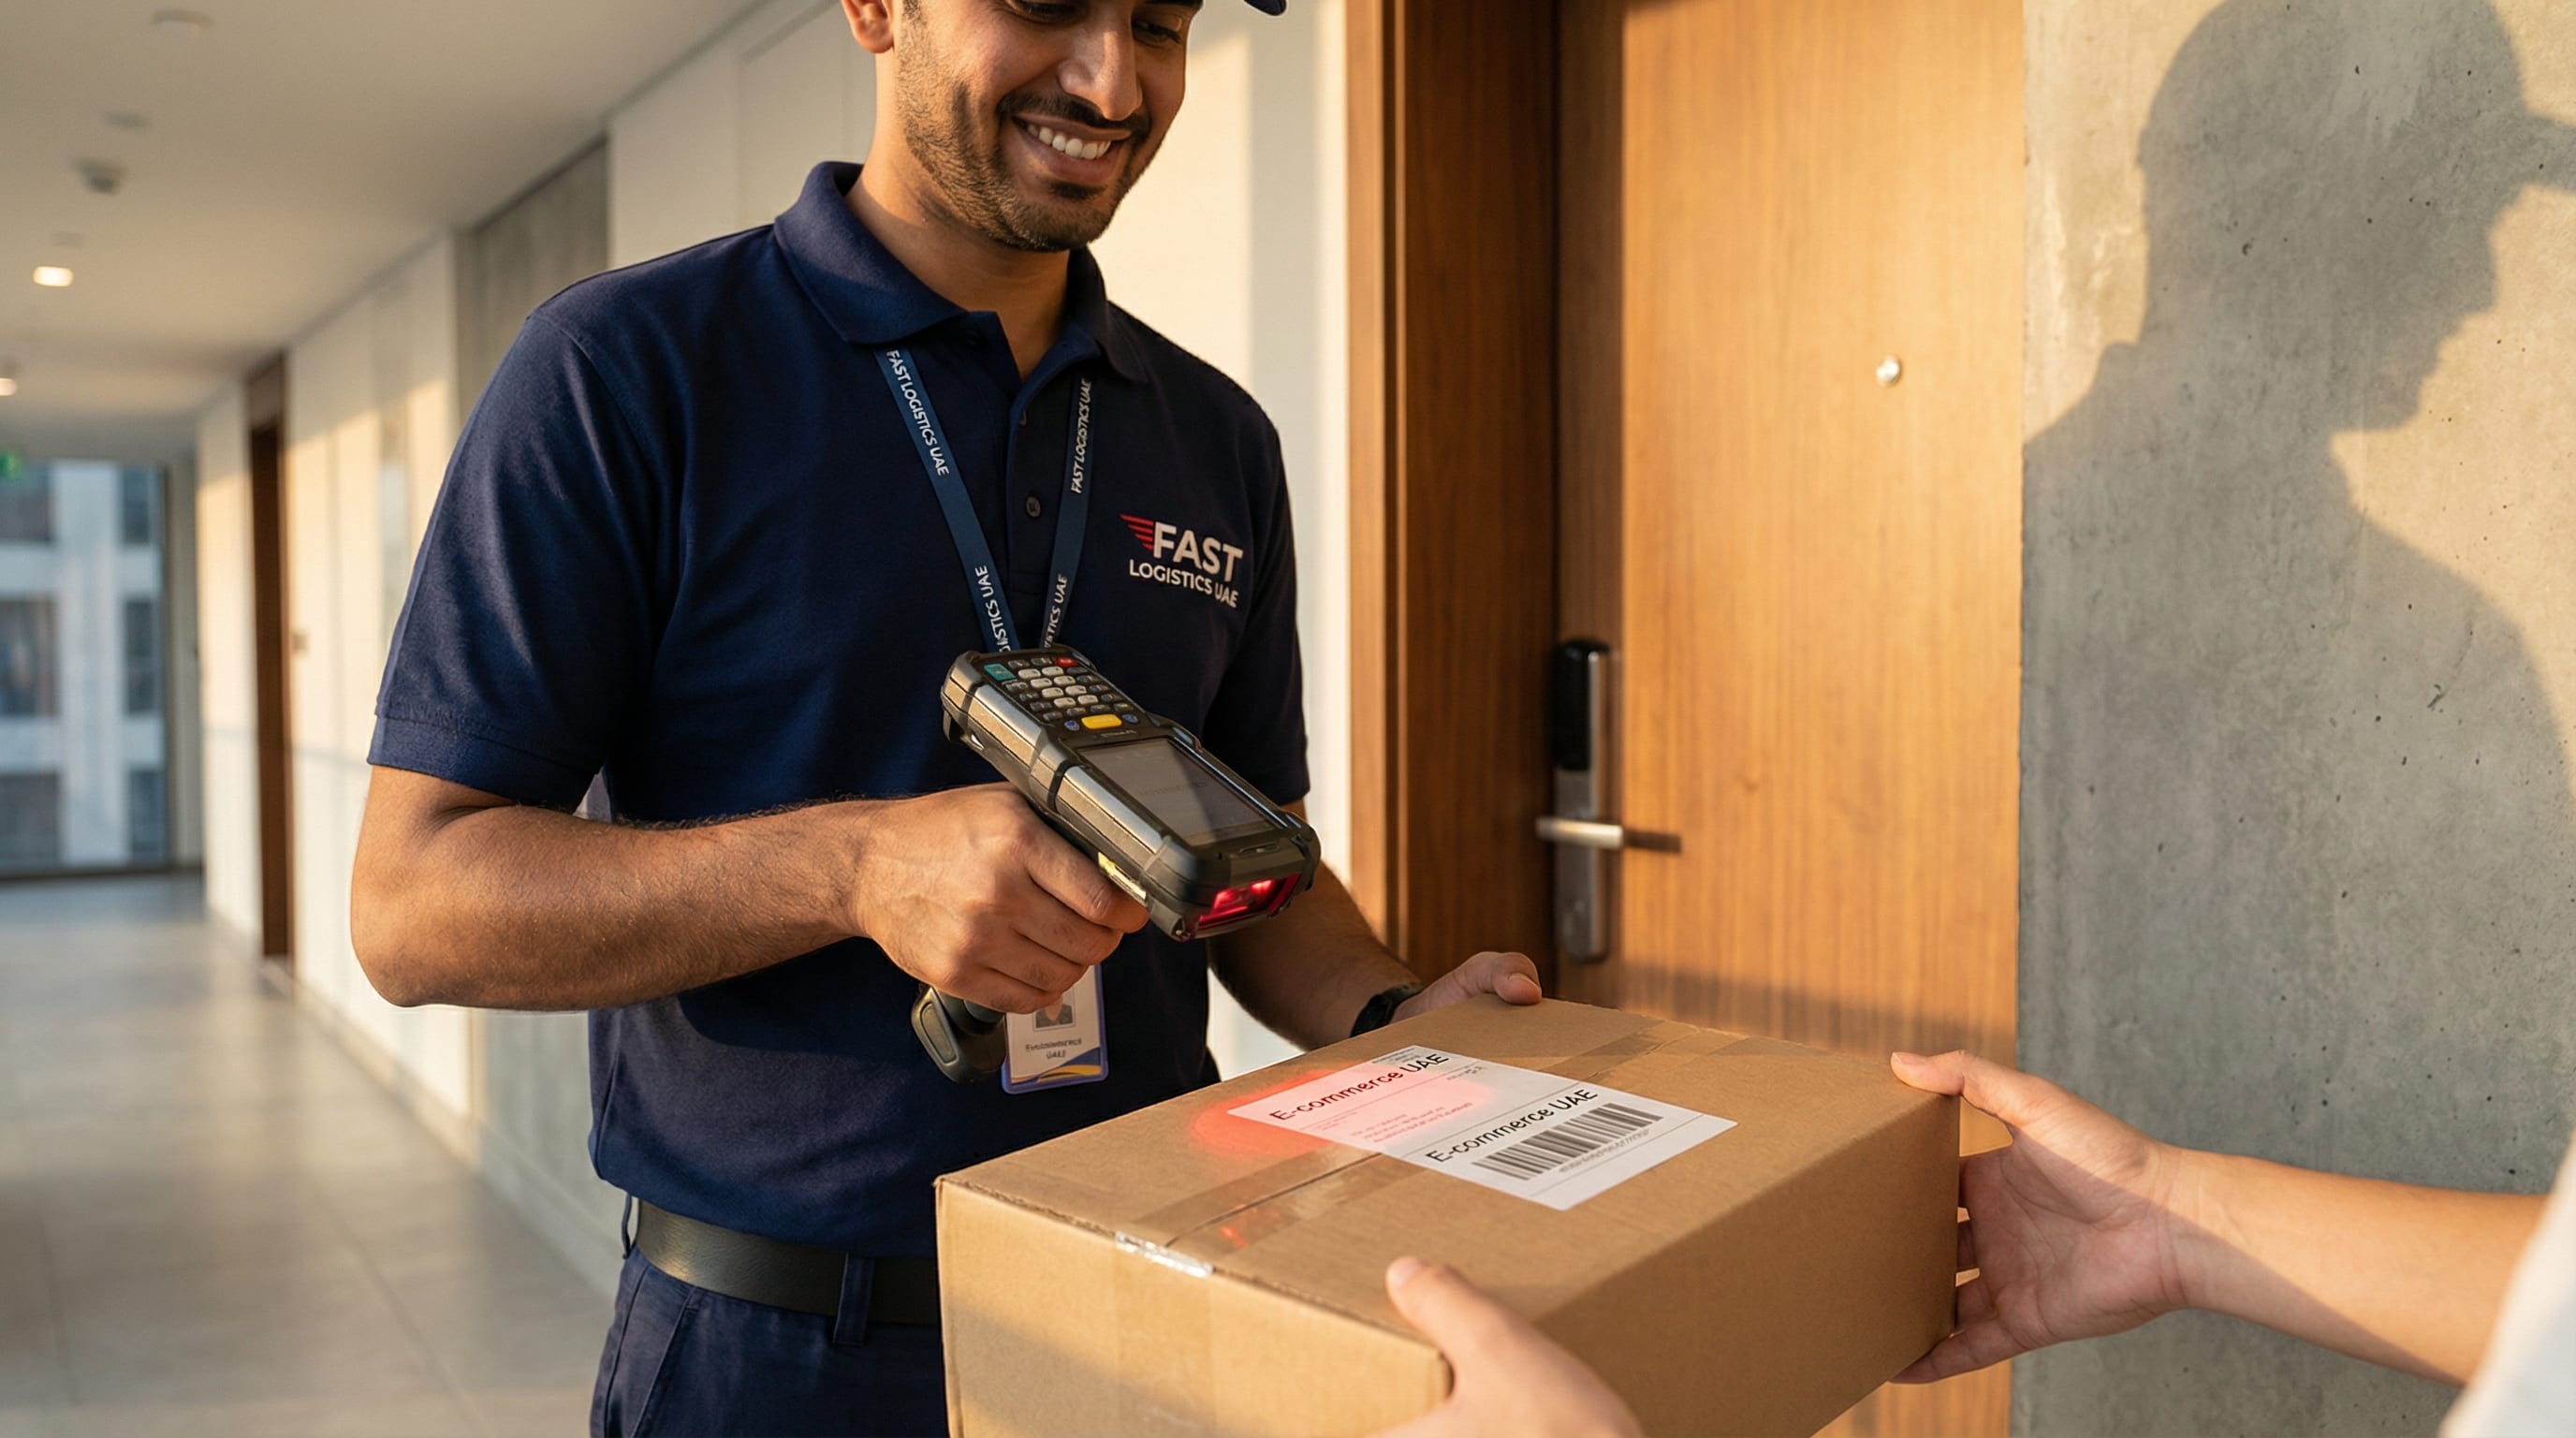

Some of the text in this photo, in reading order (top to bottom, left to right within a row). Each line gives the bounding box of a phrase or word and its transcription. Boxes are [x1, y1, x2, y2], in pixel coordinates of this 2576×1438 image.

[886, 350, 950, 476] FAST LOGISTICS UAE
[1071, 461, 1085, 493] FAST
[1153, 521, 1244, 582] FAST
[974, 565, 994, 597] UAE
[1054, 574, 1068, 604] UAE
[1129, 559, 1238, 608] LOGISTICS UAE
[1269, 1071, 1404, 1121] E-commerce
[1399, 1053, 1449, 1073] UAE
[1425, 1108, 1555, 1163] E-commerce
[1548, 1089, 1599, 1110] UAE
